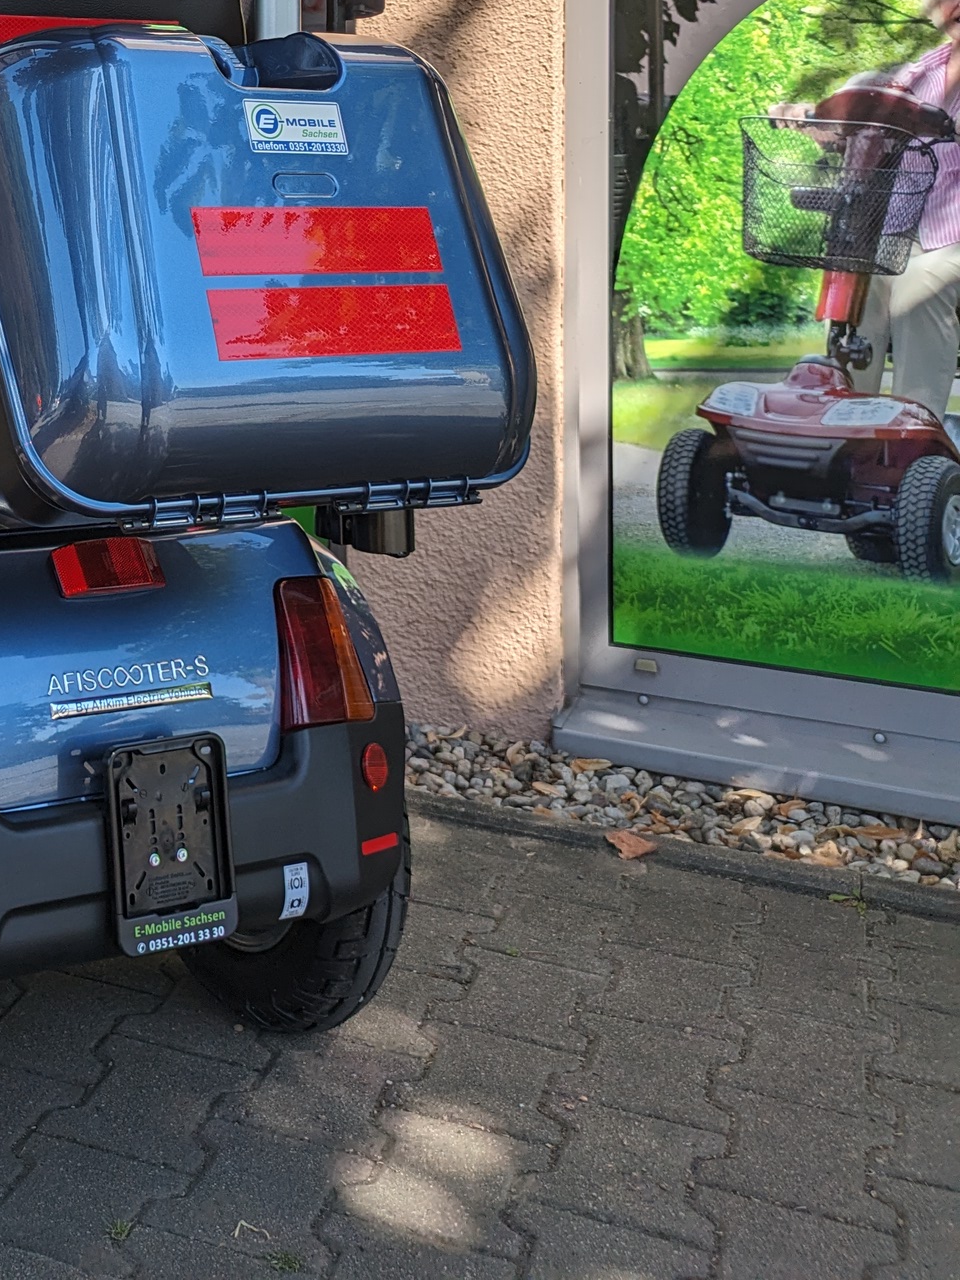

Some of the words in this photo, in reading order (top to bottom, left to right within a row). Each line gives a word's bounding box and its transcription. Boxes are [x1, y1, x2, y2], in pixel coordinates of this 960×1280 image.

[301, 129, 338, 139] Sachsen
[252, 140, 288, 151] Telefon:
[289, 142, 346, 153] 0351-2013330
[75, 702, 89, 715] By
[126, 691, 166, 707] Electric
[134, 918, 182, 938] E-Mobile
[183, 910, 226, 928] Sachsen
[149, 931, 196, 952] 0351-201
[198, 928, 211, 941] 33
[212, 925, 225, 938] 30
